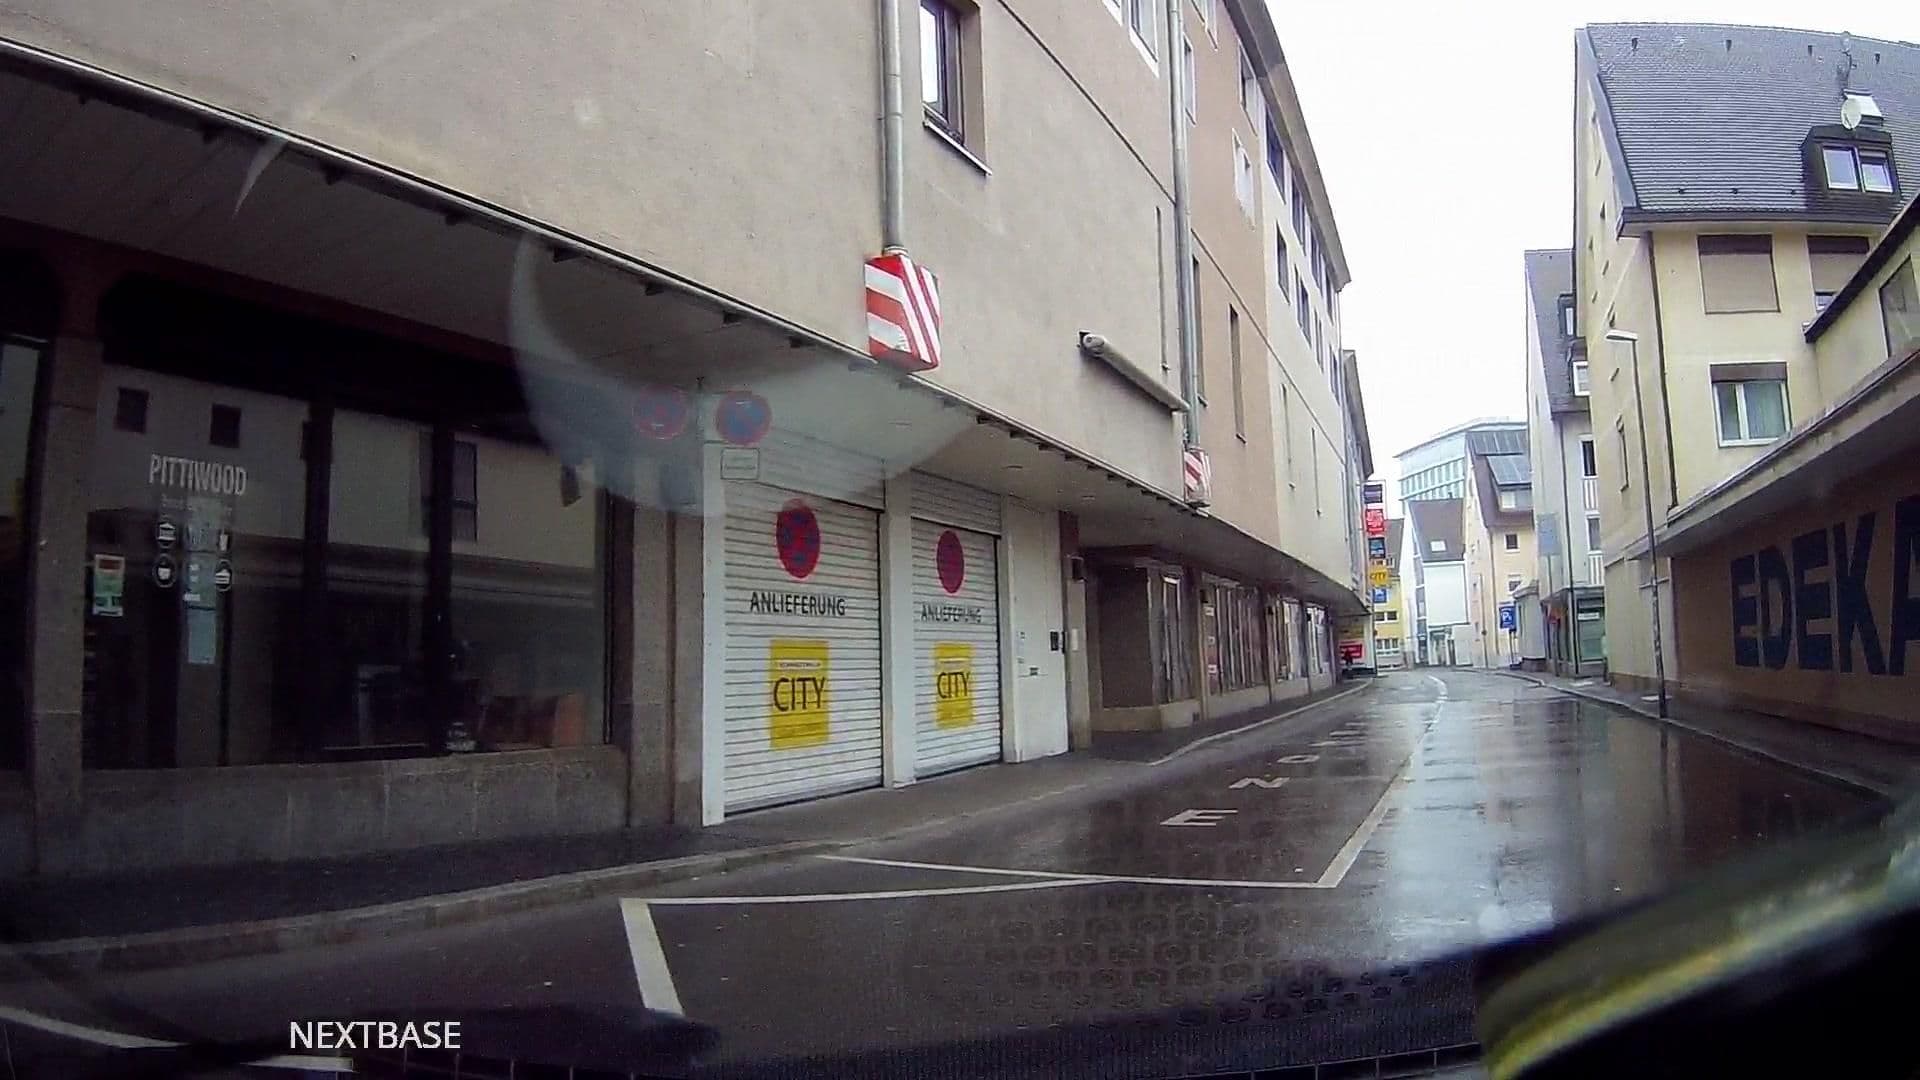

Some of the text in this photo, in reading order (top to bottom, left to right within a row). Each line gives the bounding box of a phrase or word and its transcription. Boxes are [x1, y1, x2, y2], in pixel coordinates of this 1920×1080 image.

[149, 454, 247, 496] PITTIWOOD
[750, 591, 846, 617] ANLIEFERUNG
[921, 604, 982, 623] ANLIEFERUNG
[773, 677, 825, 712] CITY
[937, 672, 970, 699] CITY
